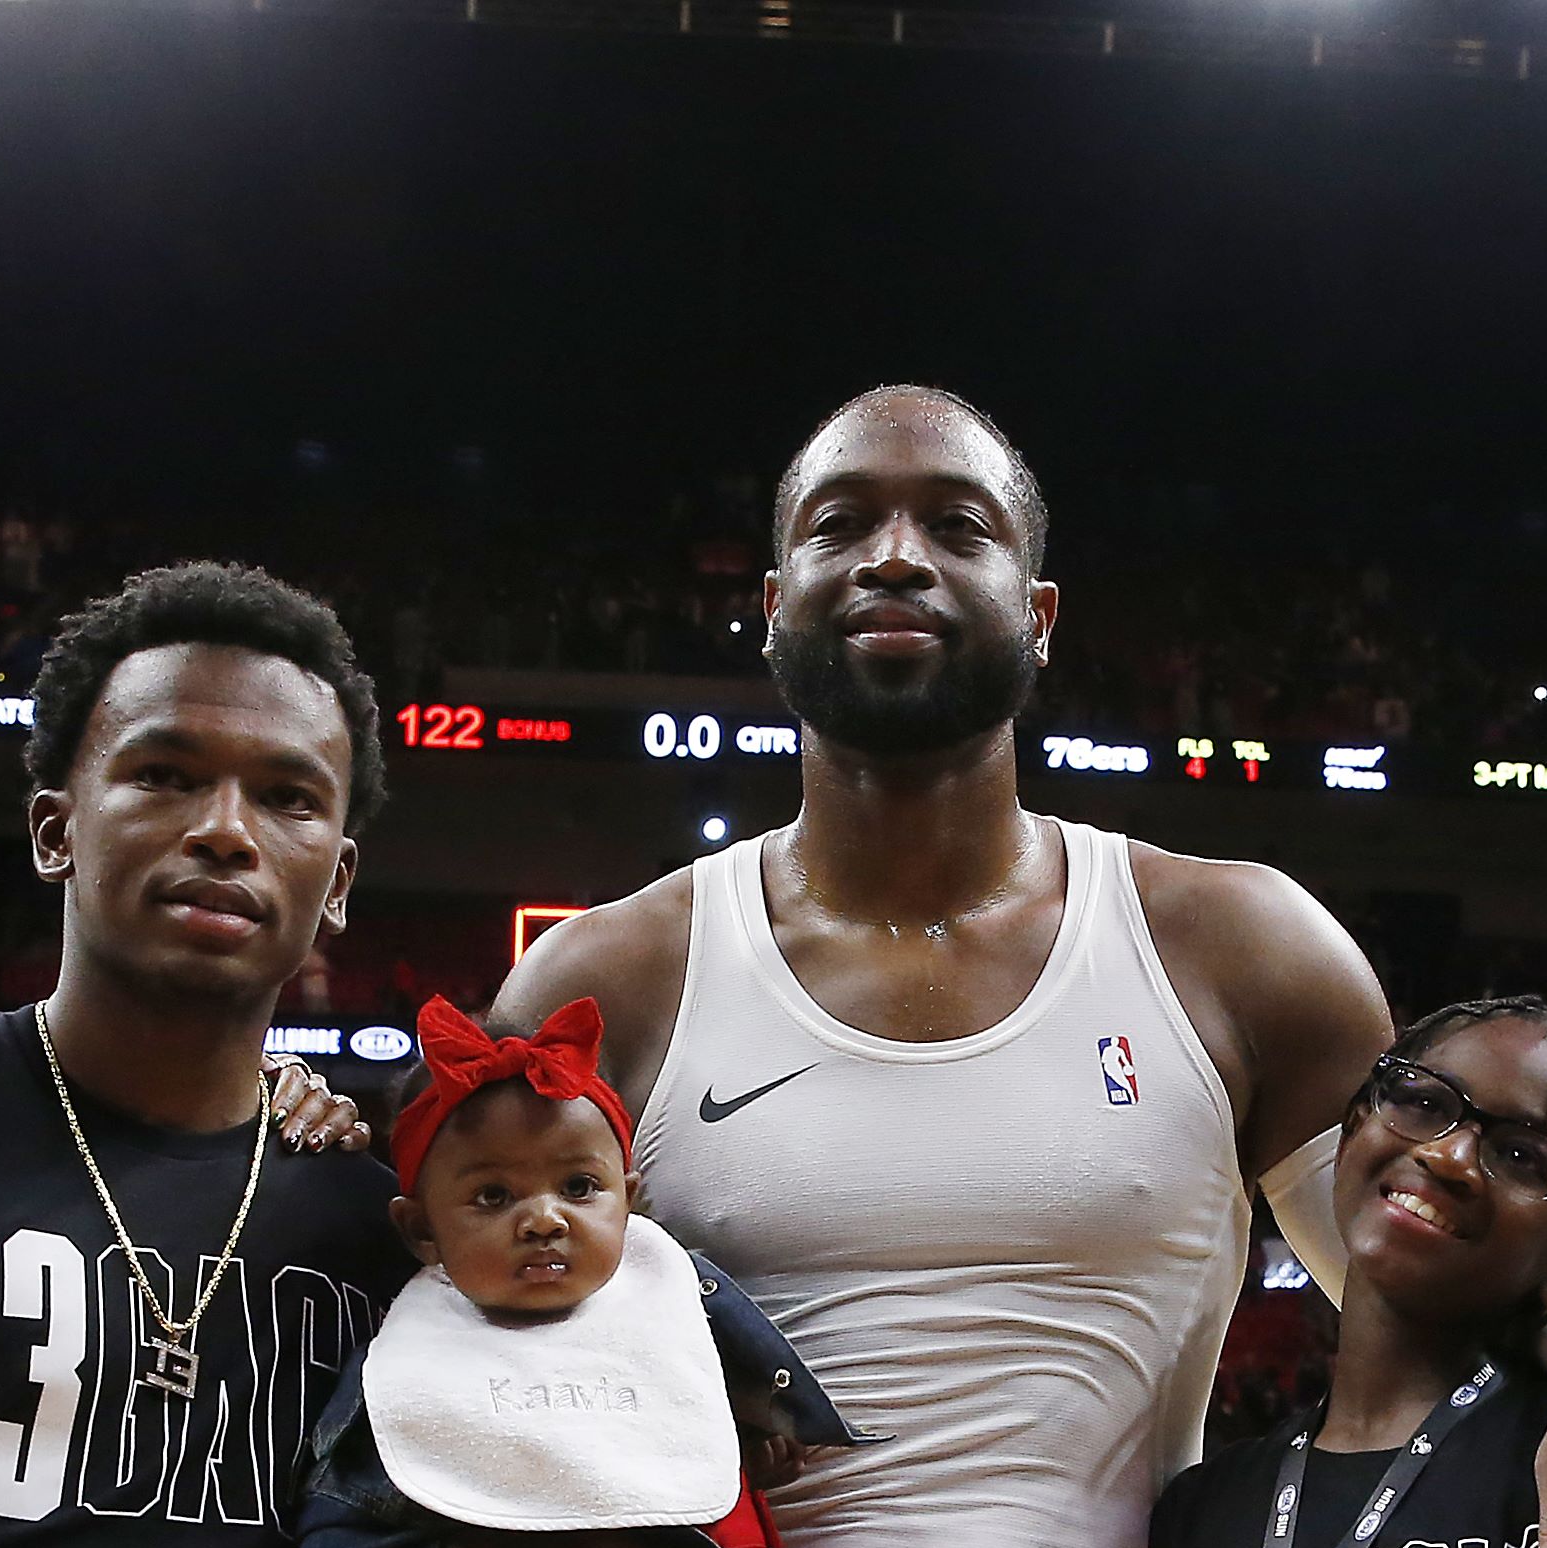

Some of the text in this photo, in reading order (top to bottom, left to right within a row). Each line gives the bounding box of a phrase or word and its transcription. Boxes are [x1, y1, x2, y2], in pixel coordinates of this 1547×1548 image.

[397, 703, 571, 749] 122 BONUS
[642, 712, 798, 760] 0.0 QTR
[1043, 736, 1149, 773] 76ers
[1177, 737, 1214, 759] FLS
[1184, 757, 1260, 782] 4 1
[1473, 760, 1533, 789] 3-PT
[1472, 1362, 1496, 1388] SUN
[488, 1376, 644, 1415] Kaavia
[1373, 1486, 1396, 1513] SUN
[1274, 1513, 1290, 1539] SUN
